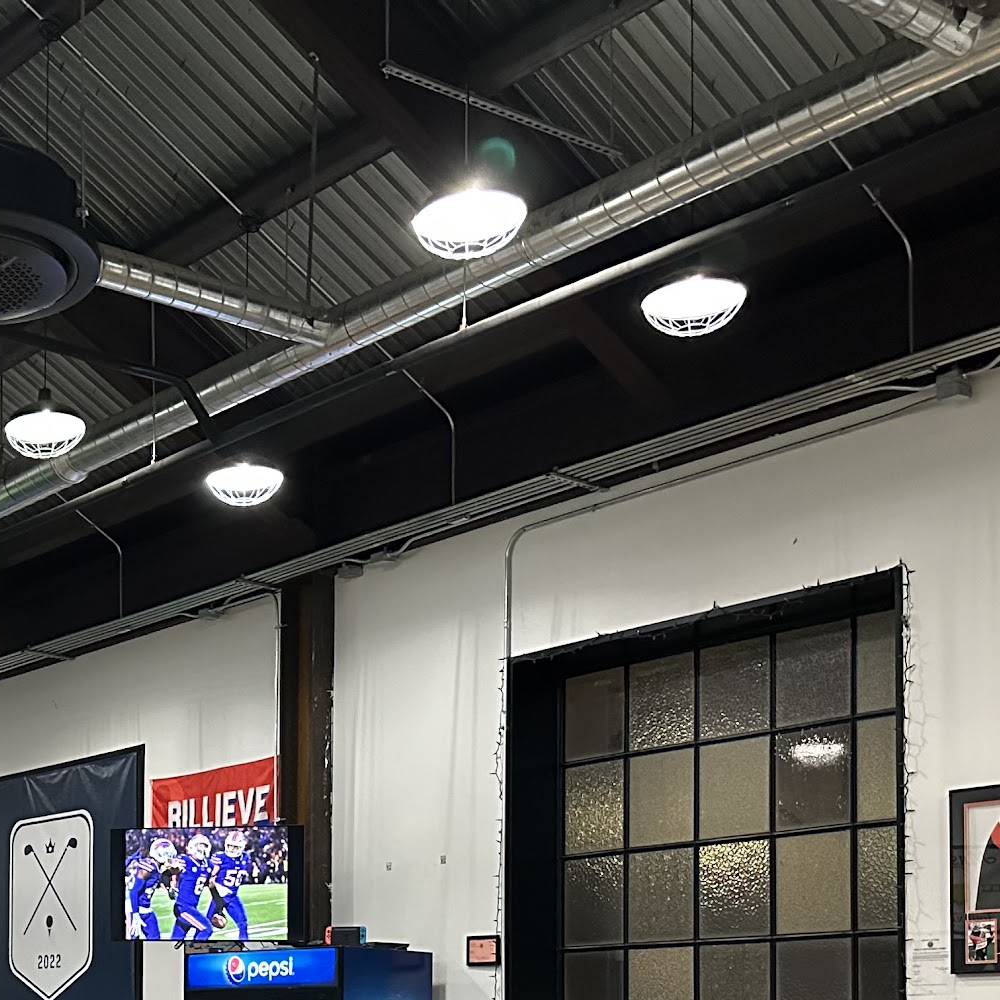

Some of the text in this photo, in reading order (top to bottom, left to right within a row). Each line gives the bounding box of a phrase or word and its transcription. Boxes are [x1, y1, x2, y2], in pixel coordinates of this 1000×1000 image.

[168, 784, 271, 828] BILLIEVE
[37, 954, 61, 969] 2022
[248, 956, 294, 982] pepsi
